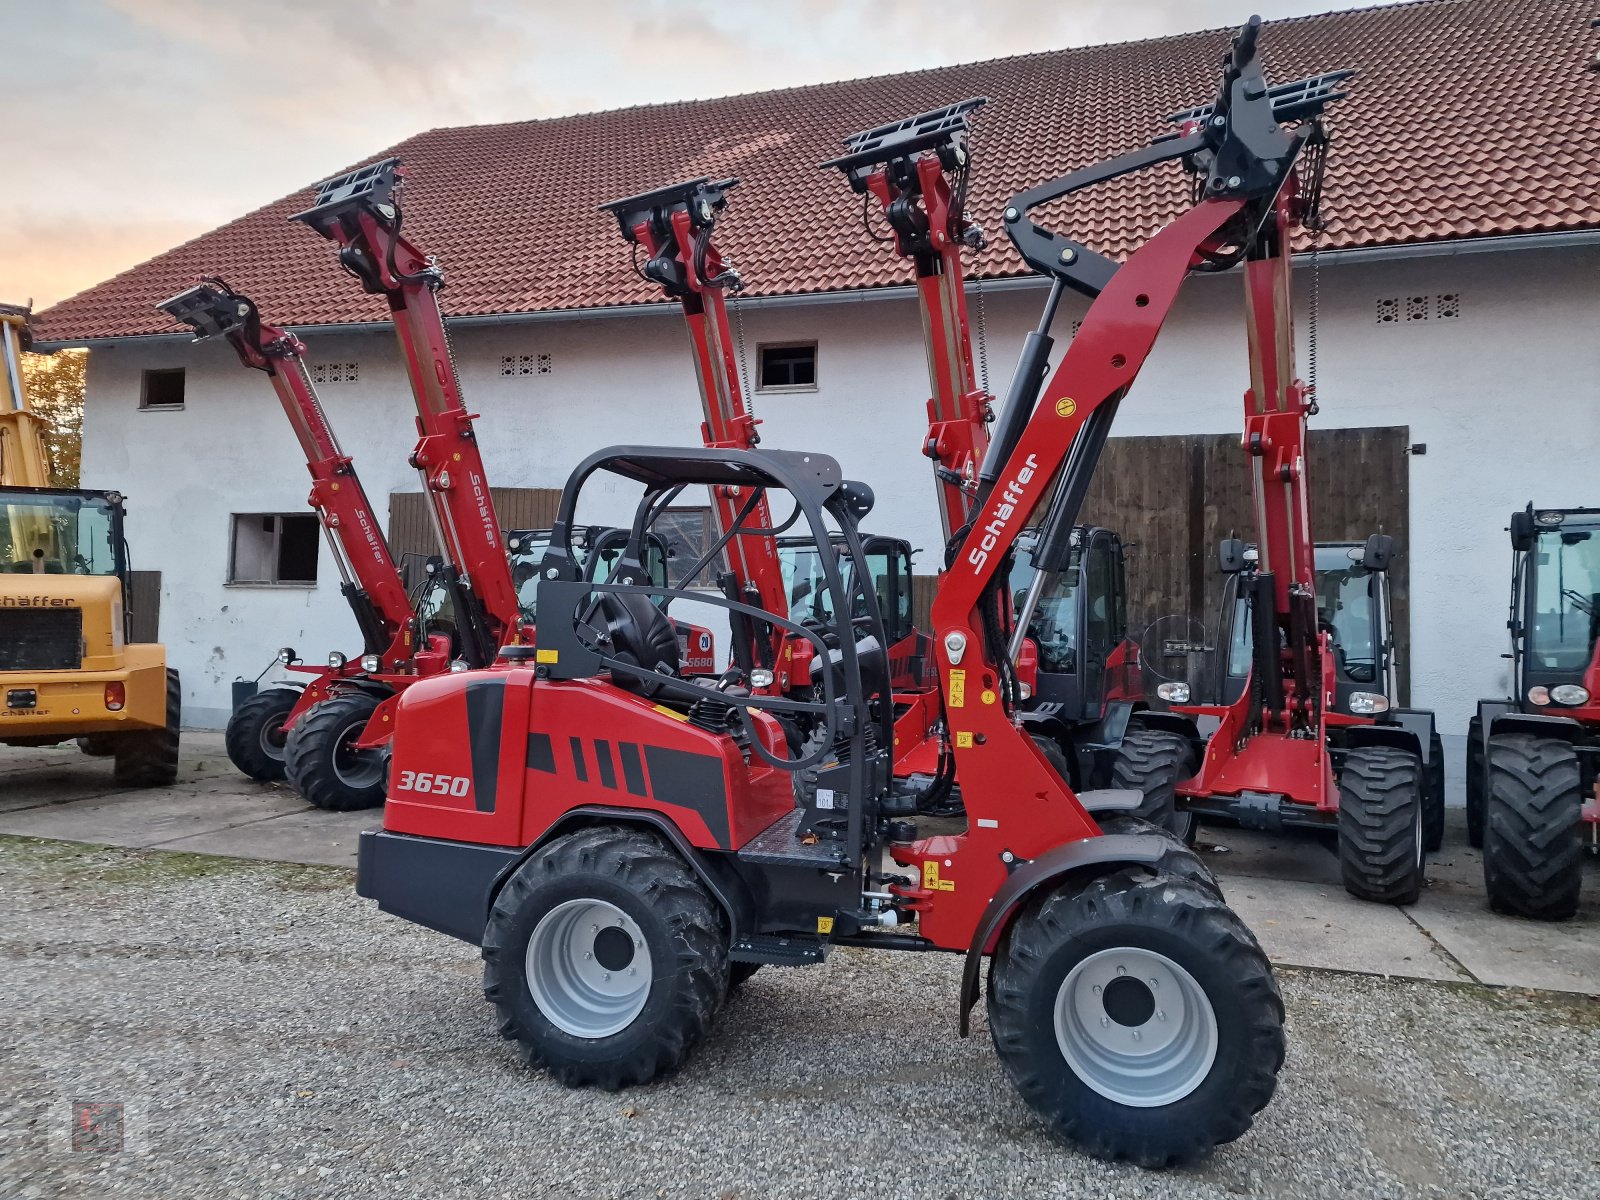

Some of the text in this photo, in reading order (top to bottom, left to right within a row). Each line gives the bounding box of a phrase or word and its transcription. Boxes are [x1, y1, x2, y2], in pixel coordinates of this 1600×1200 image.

[469, 471, 497, 549] Schäffer
[968, 453, 1038, 576] Schäffer
[354, 508, 385, 565] Schäffer
[0, 595, 75, 607] häffer
[701, 636, 709, 649] 20
[687, 657, 713, 667] 5680
[397, 770, 470, 797] 3650
